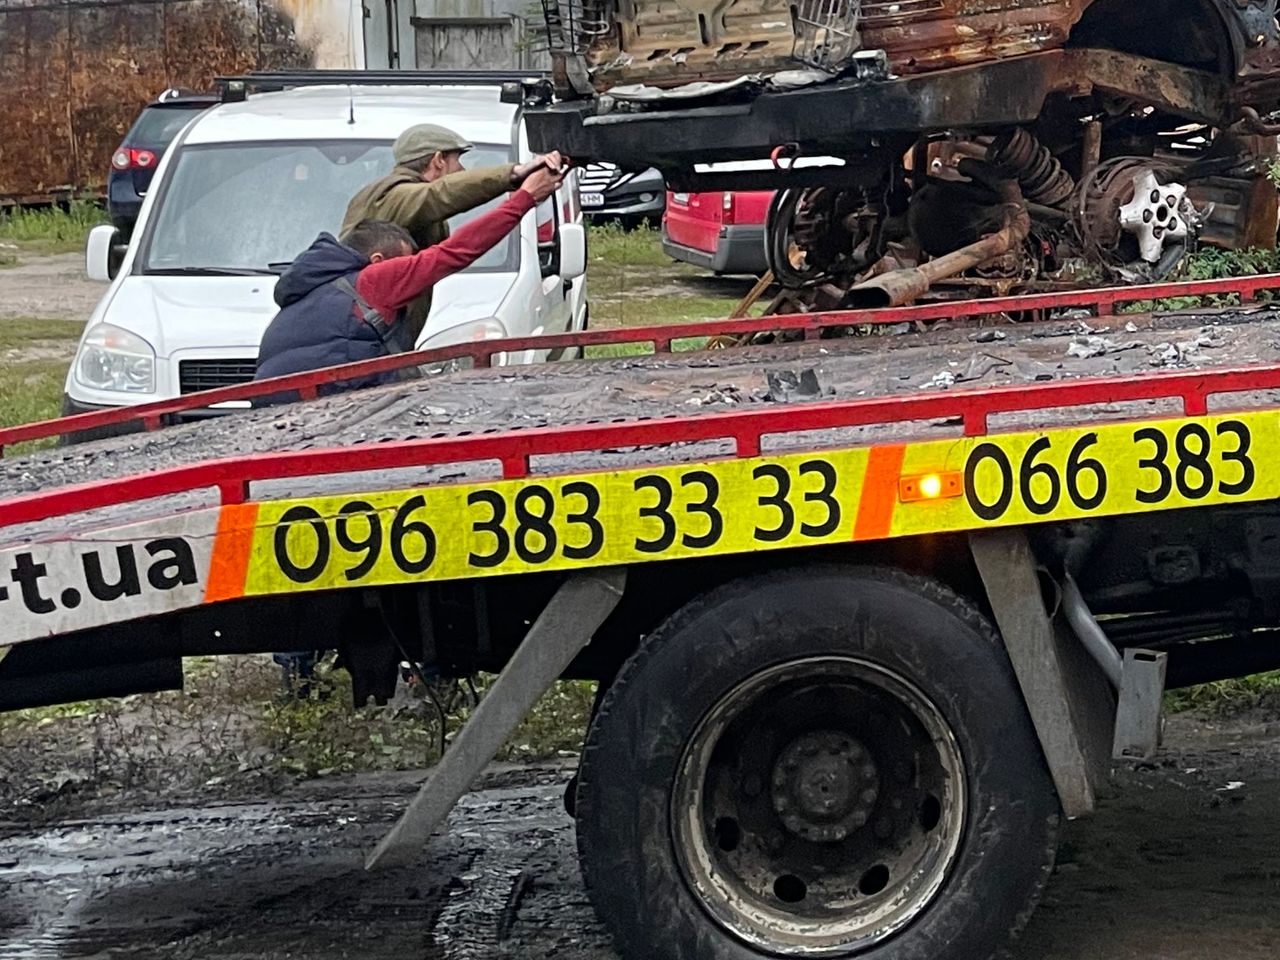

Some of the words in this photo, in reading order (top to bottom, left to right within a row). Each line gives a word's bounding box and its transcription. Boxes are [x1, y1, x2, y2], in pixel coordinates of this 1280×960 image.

[274, 495, 437, 583] 096
[467, 481, 604, 569] 383
[635, 470, 724, 553] 33
[753, 459, 842, 542] 33
[965, 433, 1108, 520] 066
[1134, 420, 1255, 503] 383
